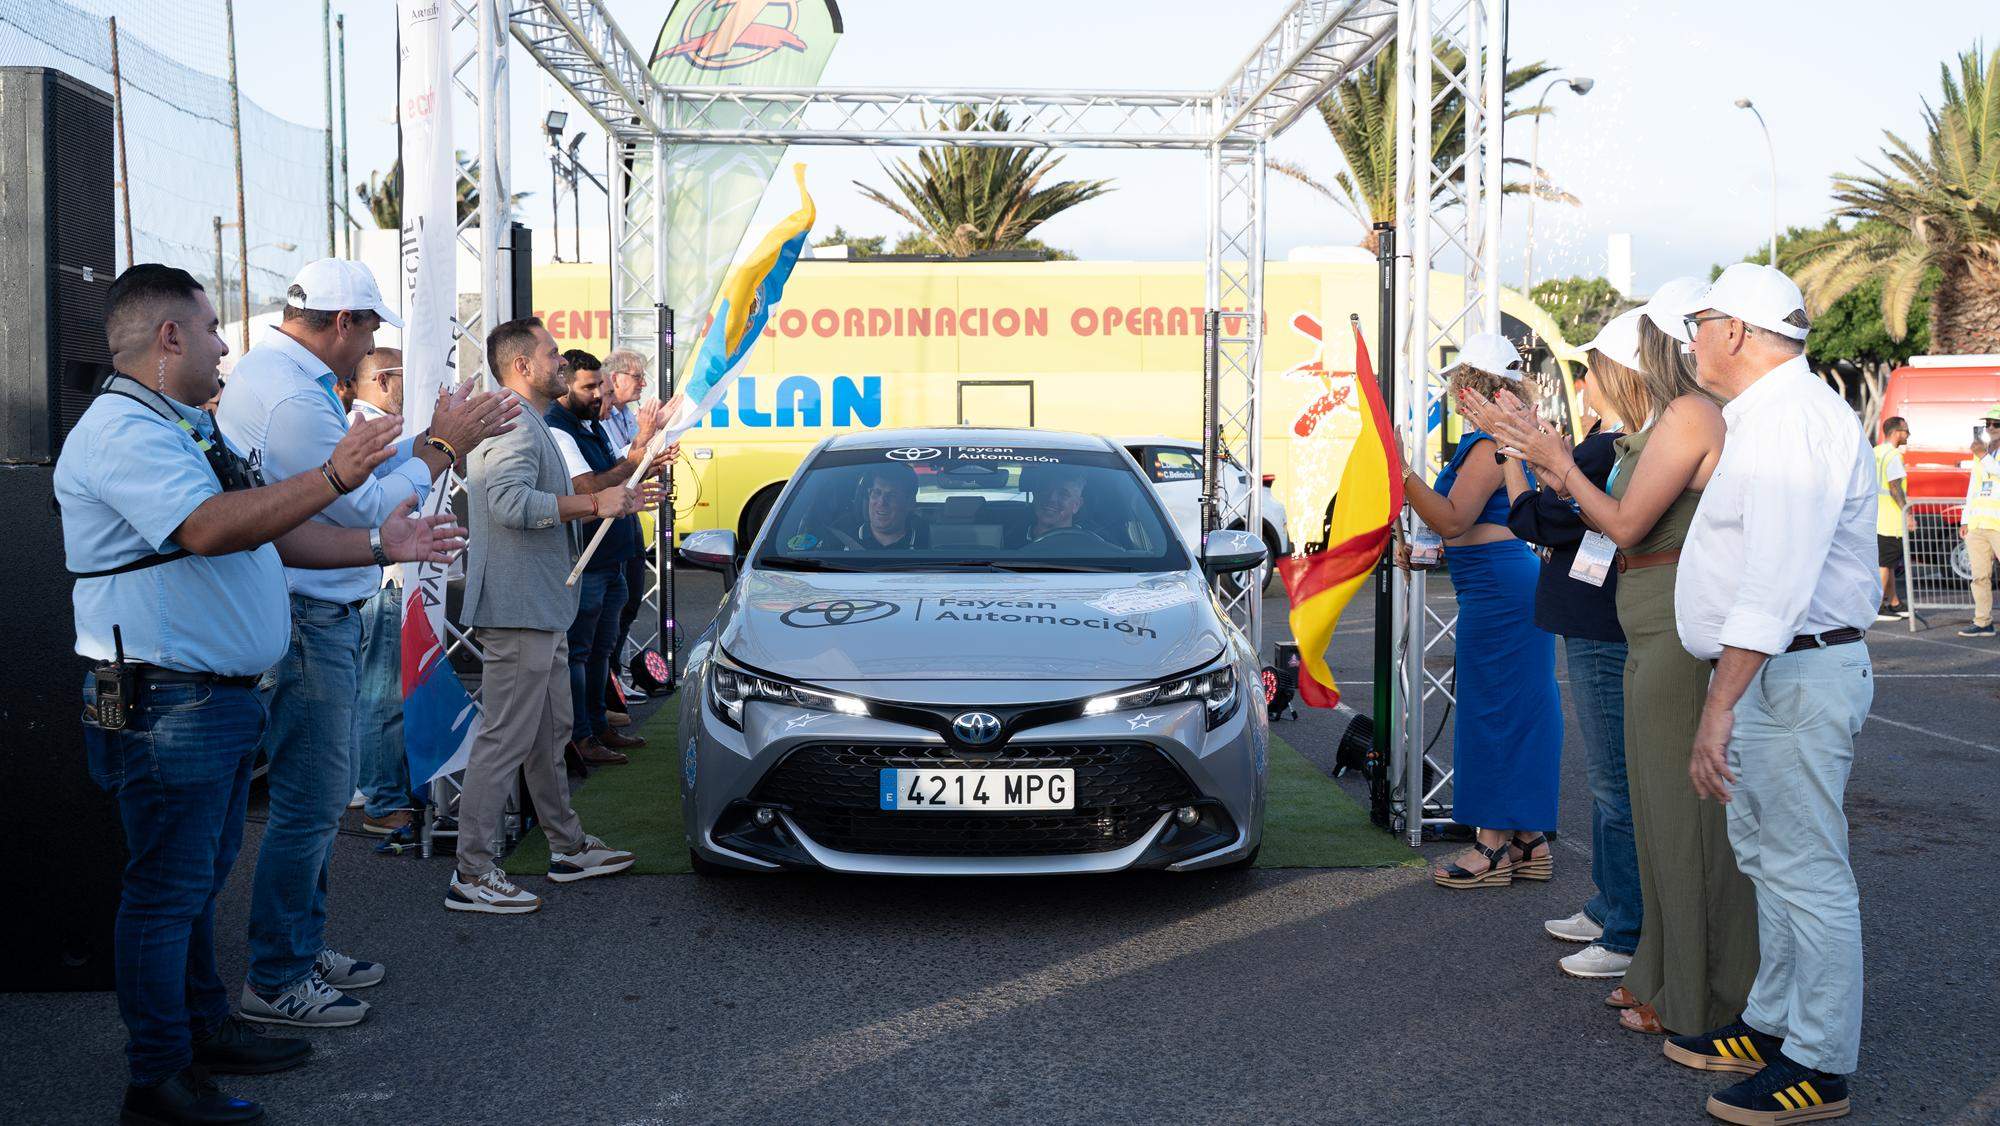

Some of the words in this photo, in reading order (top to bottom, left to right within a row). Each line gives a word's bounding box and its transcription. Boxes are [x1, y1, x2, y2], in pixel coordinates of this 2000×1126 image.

[1070, 306, 1268, 337] OPERATV
[958, 446, 1013, 454] Faycan
[958, 453, 1060, 463] Automoción
[938, 598, 1057, 610] Faycan
[934, 610, 1158, 639] Automoción
[907, 775, 990, 805] 4214
[1004, 774, 1066, 805] MPG
[886, 793, 894, 802] E
